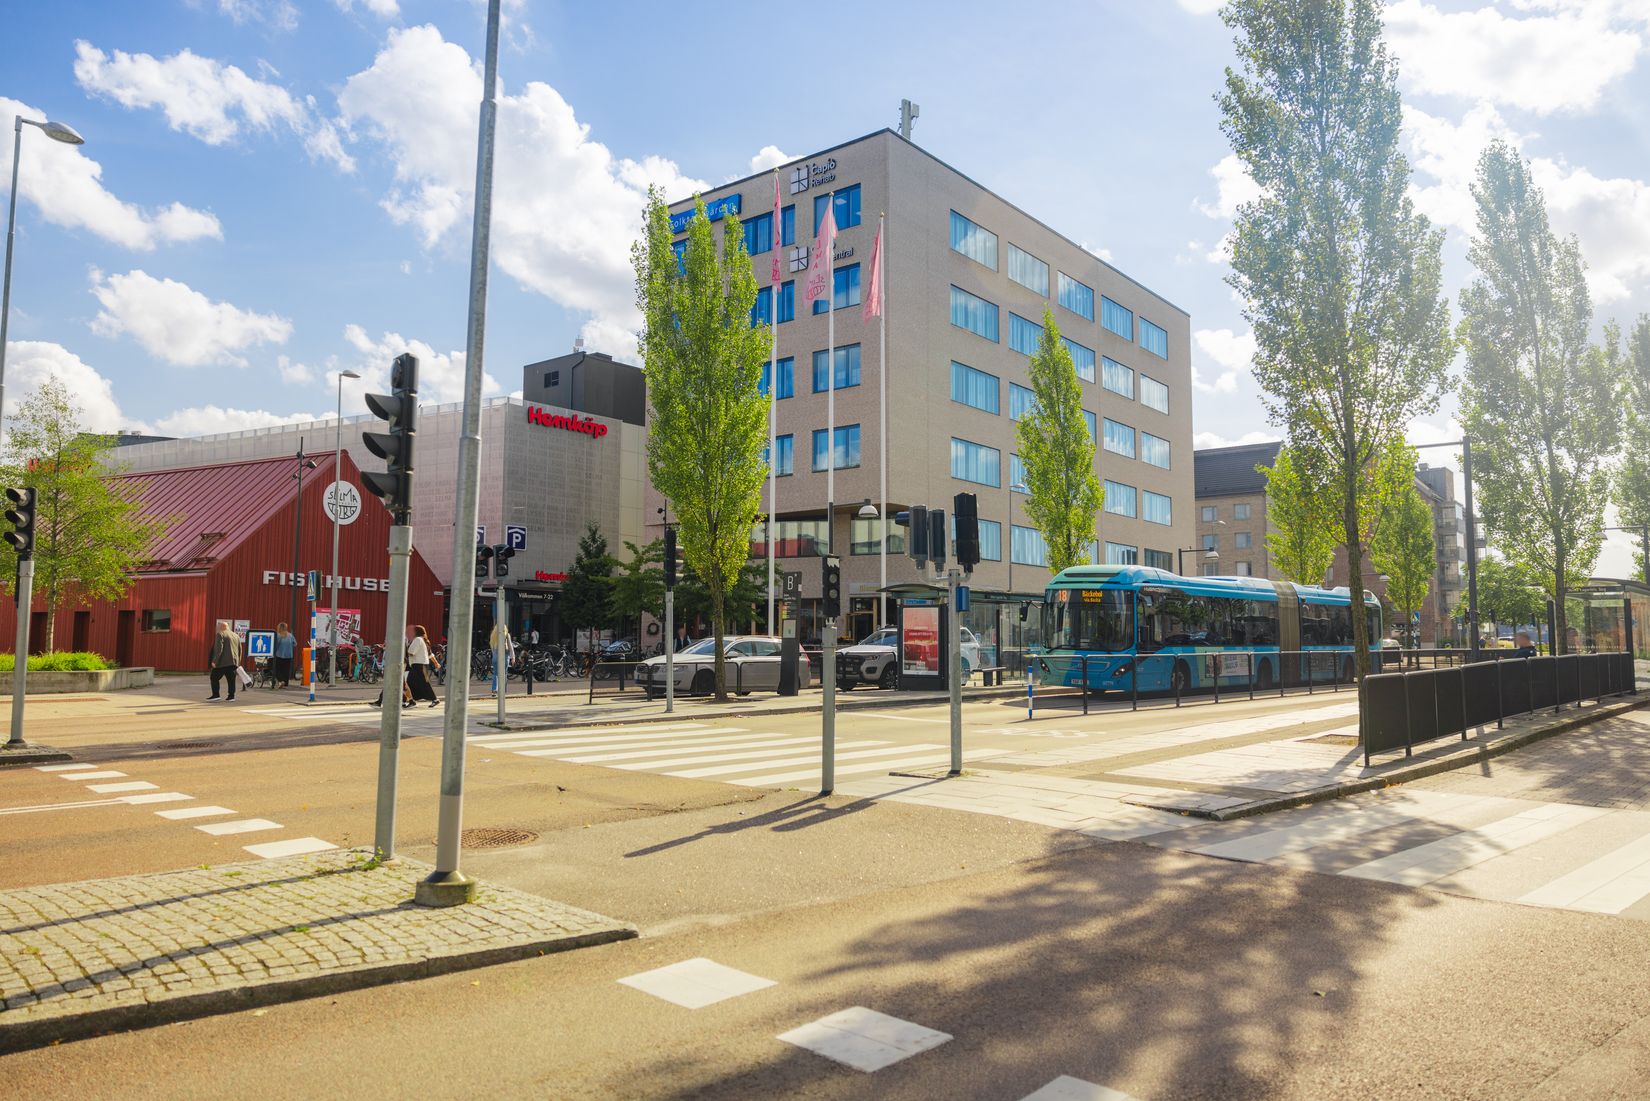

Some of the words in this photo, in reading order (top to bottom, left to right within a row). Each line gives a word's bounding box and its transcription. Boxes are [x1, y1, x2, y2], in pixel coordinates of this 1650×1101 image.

[811, 160, 836, 175] Capio
[811, 173, 835, 187] Rehab
[528, 405, 608, 438] Hemköp
[513, 533, 522, 548] P
[262, 570, 391, 592] FISHUSE
[536, 570, 567, 581] Hemk
[787, 575, 794, 590] B
[518, 592, 543, 600] Välkommen
[1059, 590, 1068, 602] 18
